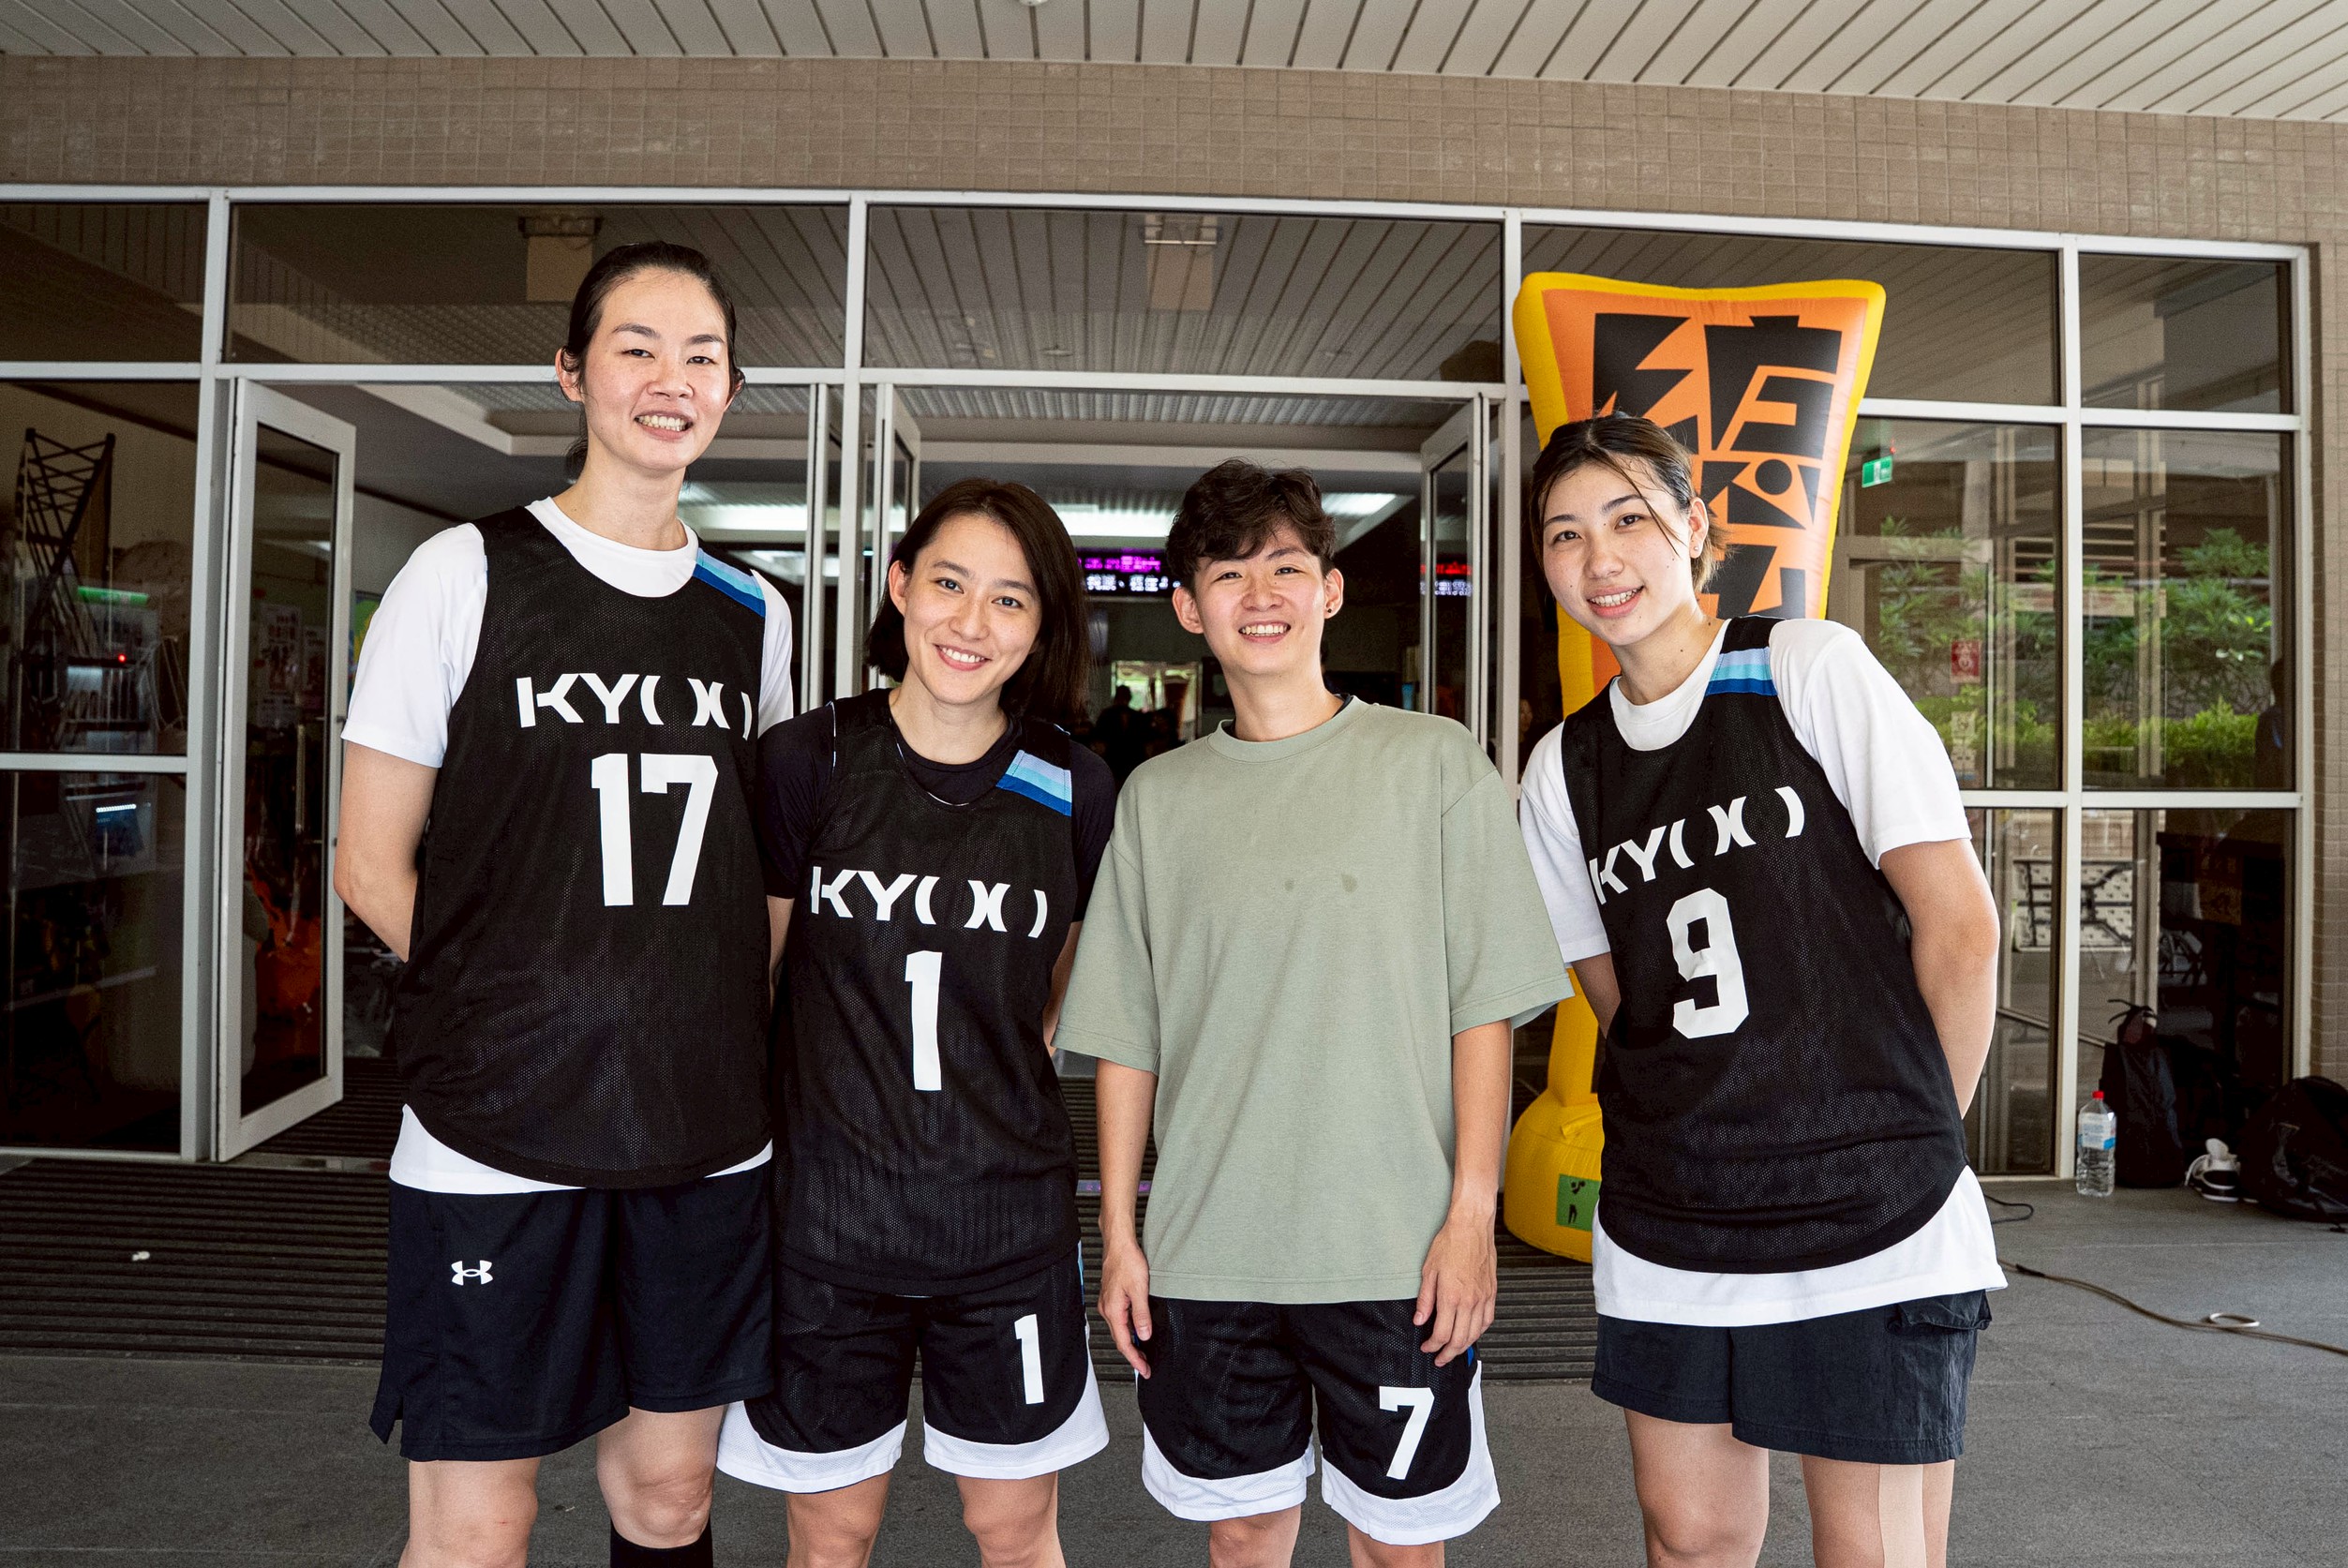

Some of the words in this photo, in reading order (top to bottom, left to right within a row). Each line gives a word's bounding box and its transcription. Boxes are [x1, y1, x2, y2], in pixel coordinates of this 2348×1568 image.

[591, 753, 719, 907] 17
[905, 949, 943, 1091] 1
[1666, 887, 1750, 1039] 9
[1013, 1313, 1045, 1405] 1
[1379, 1385, 1435, 1480] 7
